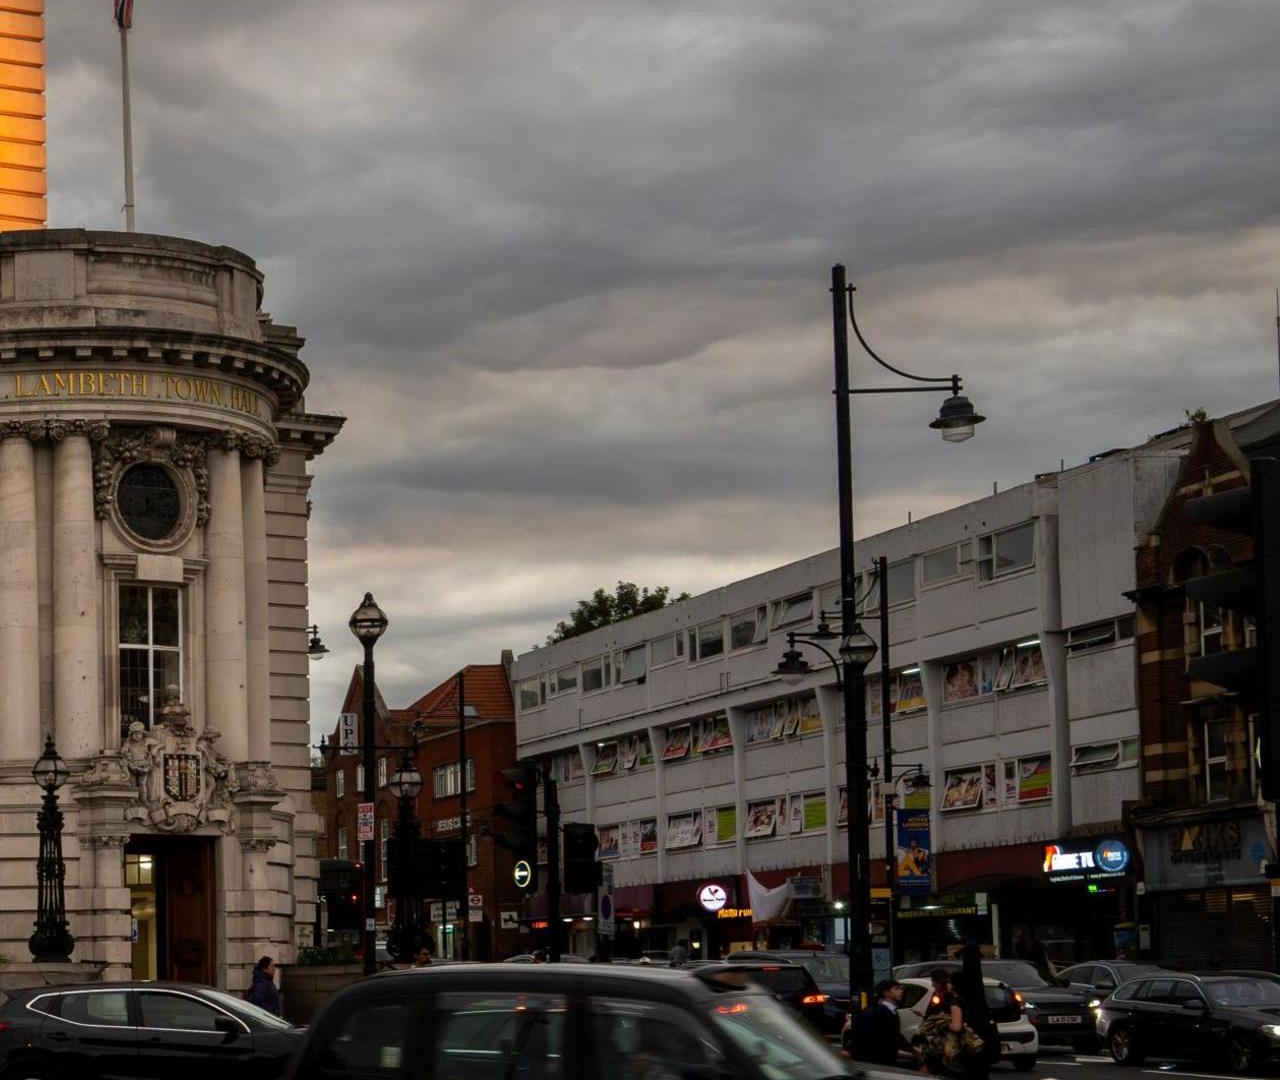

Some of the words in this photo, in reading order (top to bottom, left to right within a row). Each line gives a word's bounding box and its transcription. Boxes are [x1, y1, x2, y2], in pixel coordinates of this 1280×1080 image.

[14, 372, 148, 398] LAMBETH
[162, 375, 223, 406] TOWN
[230, 388, 263, 418] HALL
